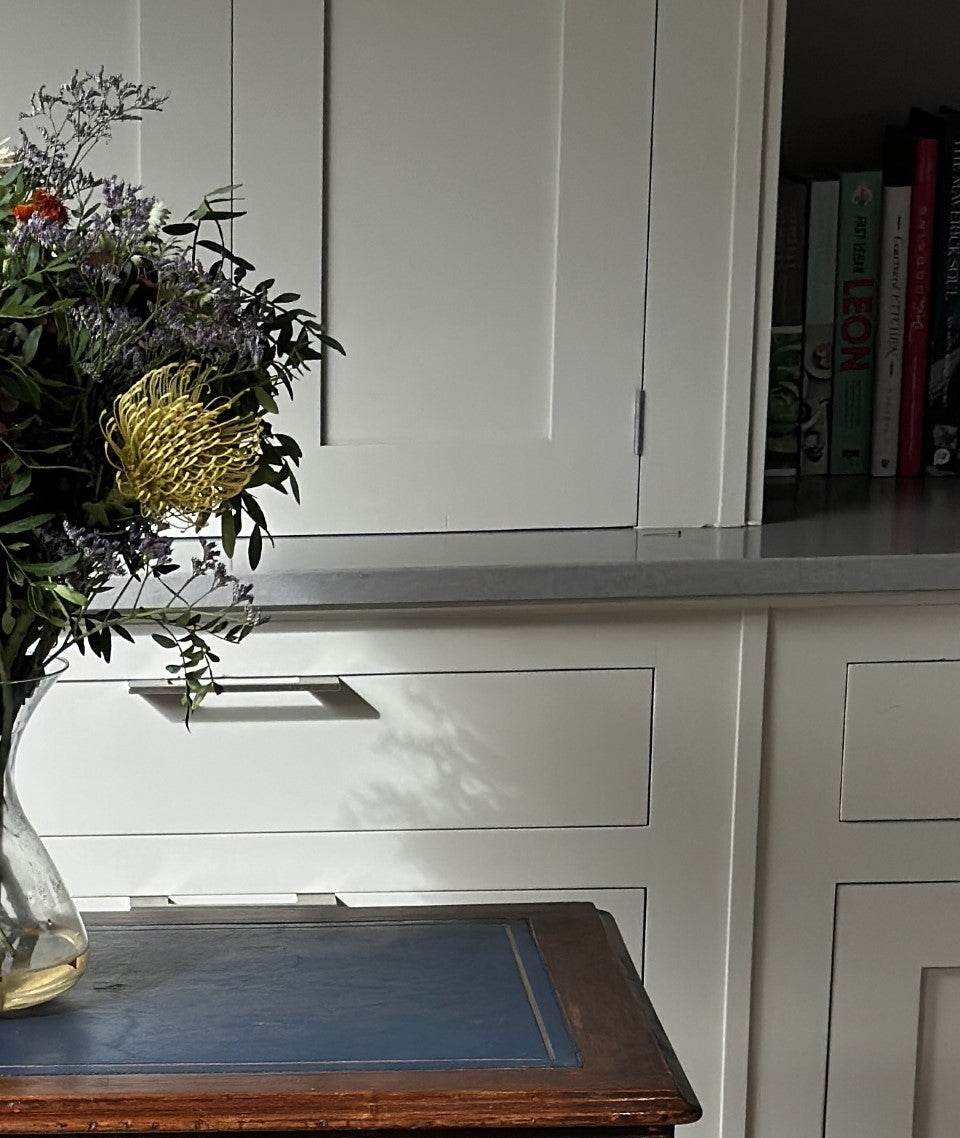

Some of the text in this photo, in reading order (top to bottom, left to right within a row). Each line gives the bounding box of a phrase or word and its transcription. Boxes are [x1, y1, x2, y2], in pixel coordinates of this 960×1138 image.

[853, 217, 866, 273] FAST VEGAN
[945, 261, 959, 301] SOUL
[841, 279, 873, 371] LEON
